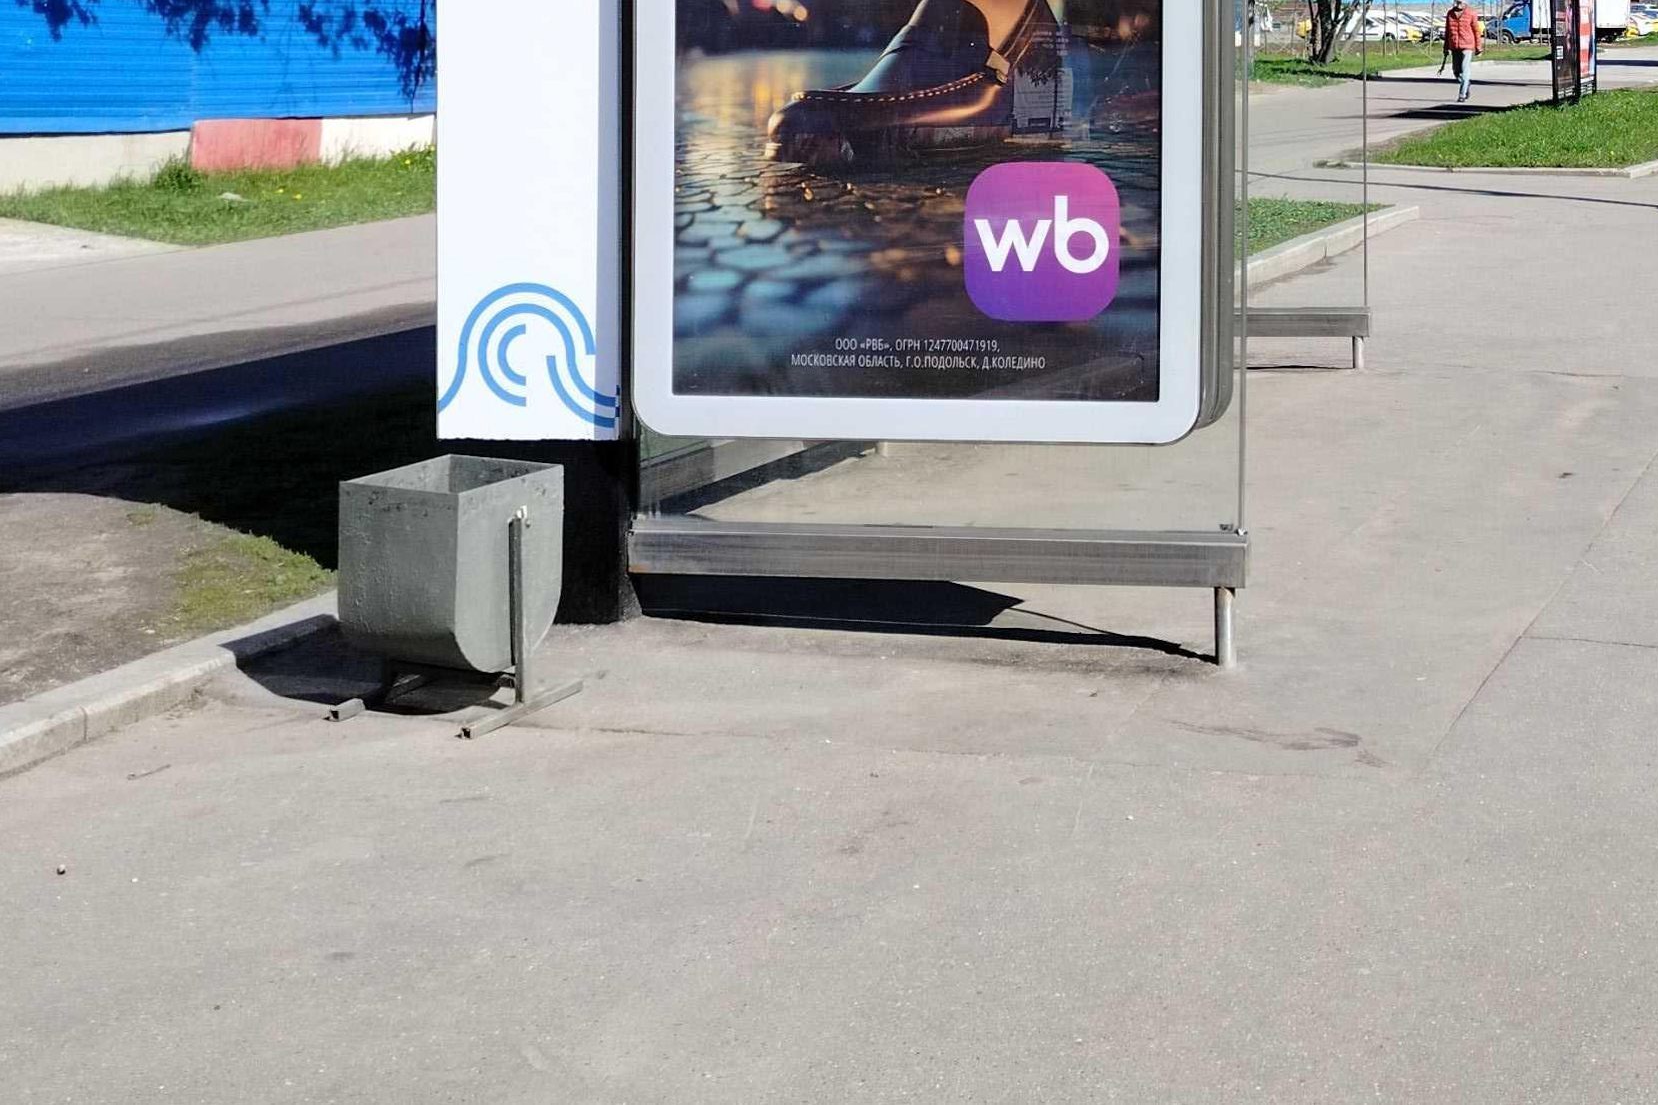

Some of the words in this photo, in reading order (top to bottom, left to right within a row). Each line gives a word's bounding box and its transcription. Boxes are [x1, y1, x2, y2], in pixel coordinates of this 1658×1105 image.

[974, 195, 1110, 274] wb
[835, 338, 857, 351] ООО
[895, 339, 920, 351] ОГРН
[924, 339, 1000, 353] 1247700471919,
[791, 354, 856, 367] МОСКОВСКАЯ
[858, 355, 904, 368] ОБЛАСТЬ,
